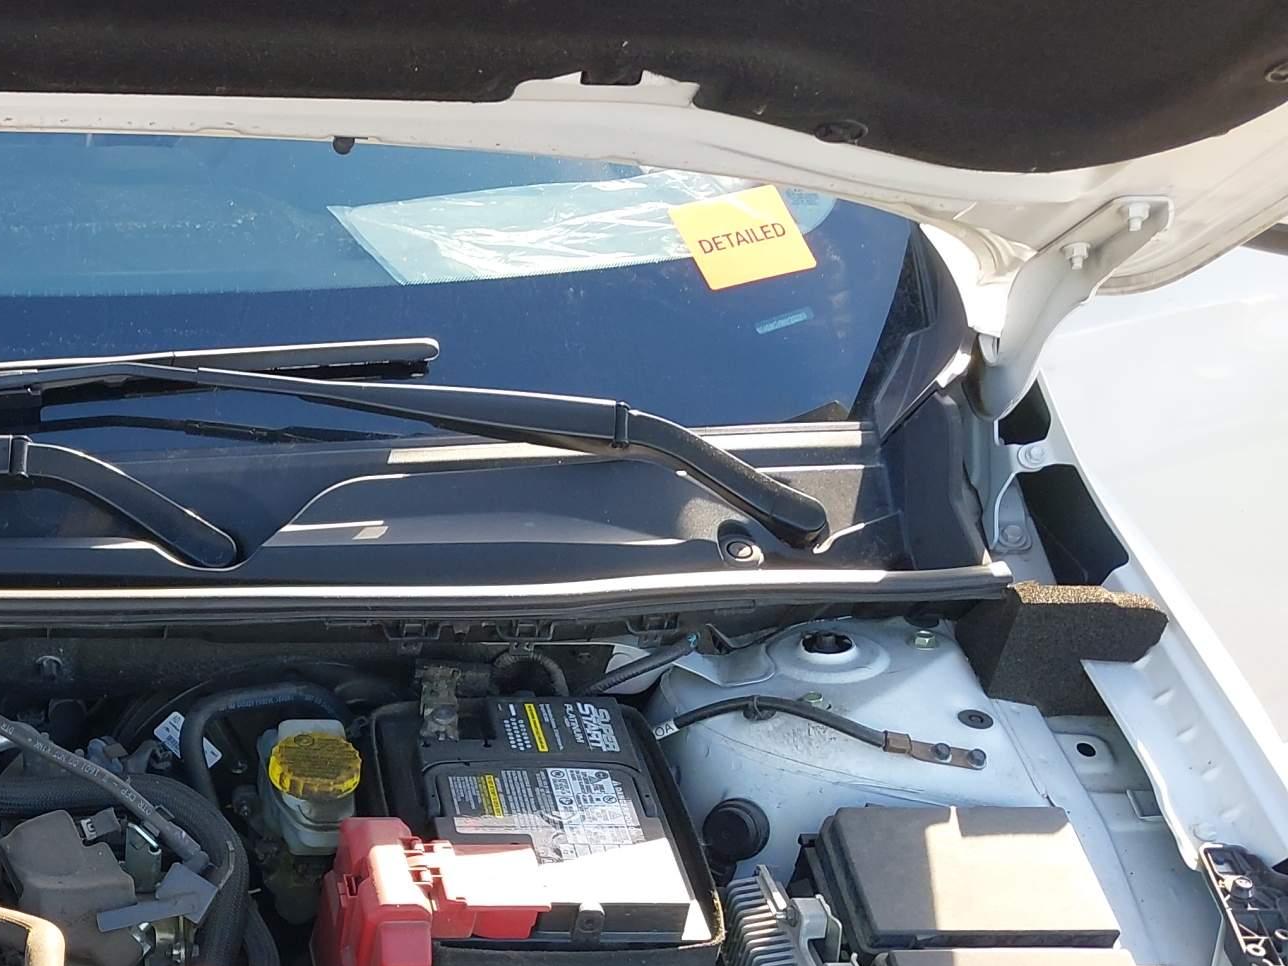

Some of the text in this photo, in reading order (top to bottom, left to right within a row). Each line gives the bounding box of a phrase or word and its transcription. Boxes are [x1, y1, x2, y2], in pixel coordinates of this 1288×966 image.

[698, 223, 786, 254] DETAILED
[564, 703, 584, 744] PLATINUM
[576, 702, 607, 751] START
[598, 708, 620, 752] SUPER
